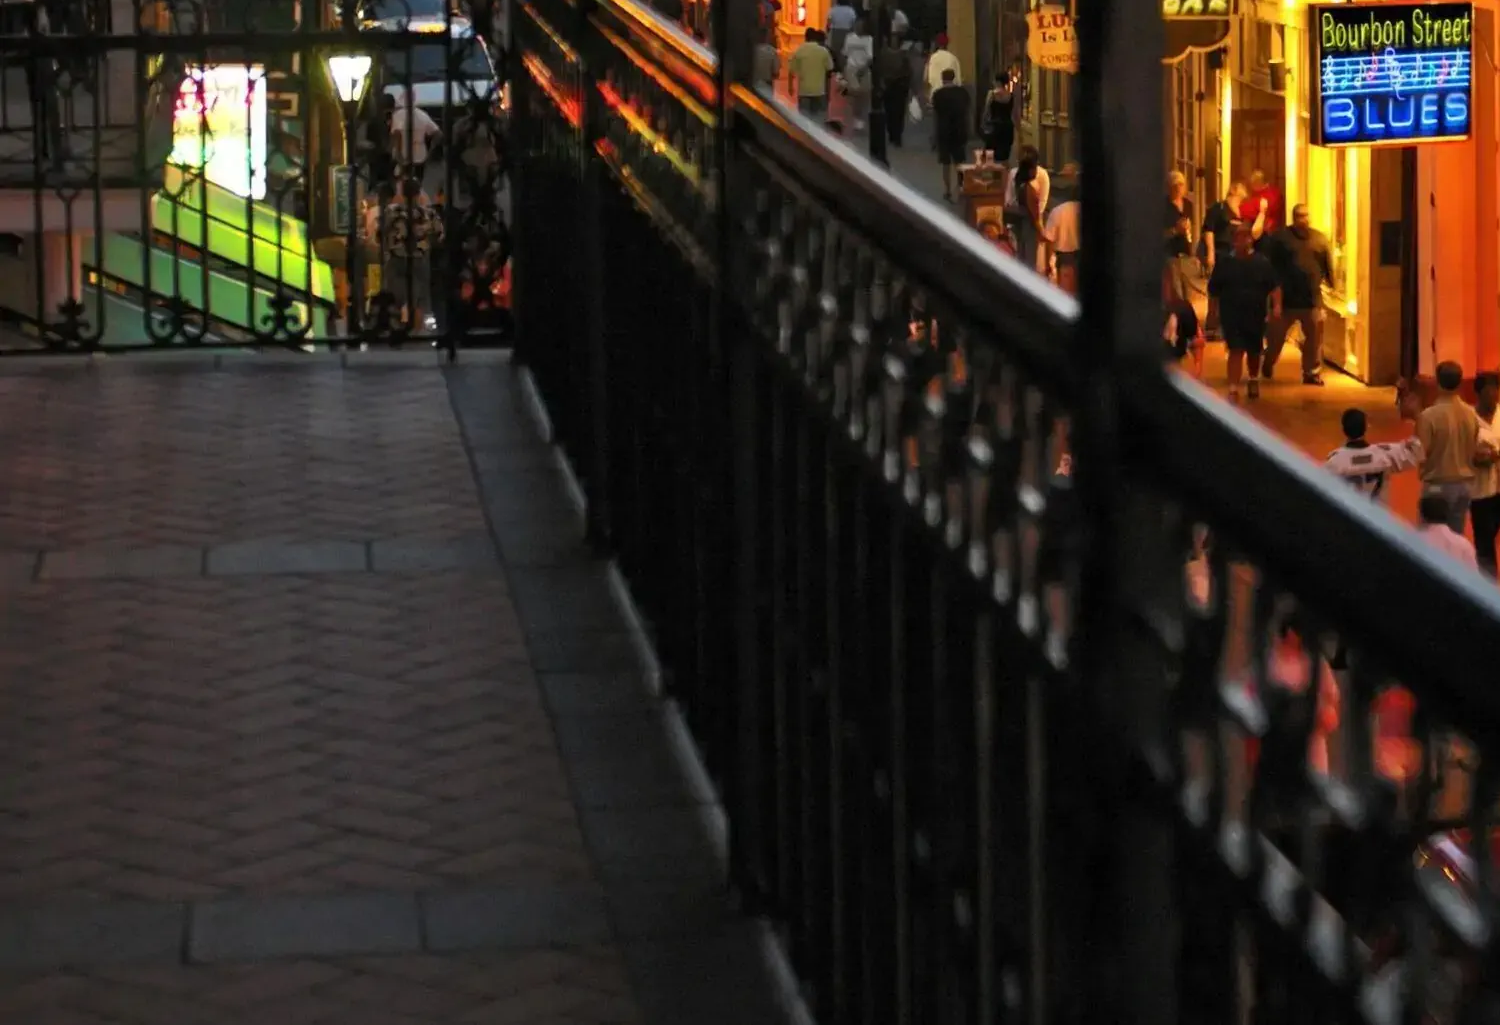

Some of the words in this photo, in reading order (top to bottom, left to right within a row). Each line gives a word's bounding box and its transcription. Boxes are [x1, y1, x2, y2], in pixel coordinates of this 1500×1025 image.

[1321, 11, 1406, 47] Bourbon
[1412, 8, 1471, 45] Street
[1325, 92, 1469, 134] BLUES
